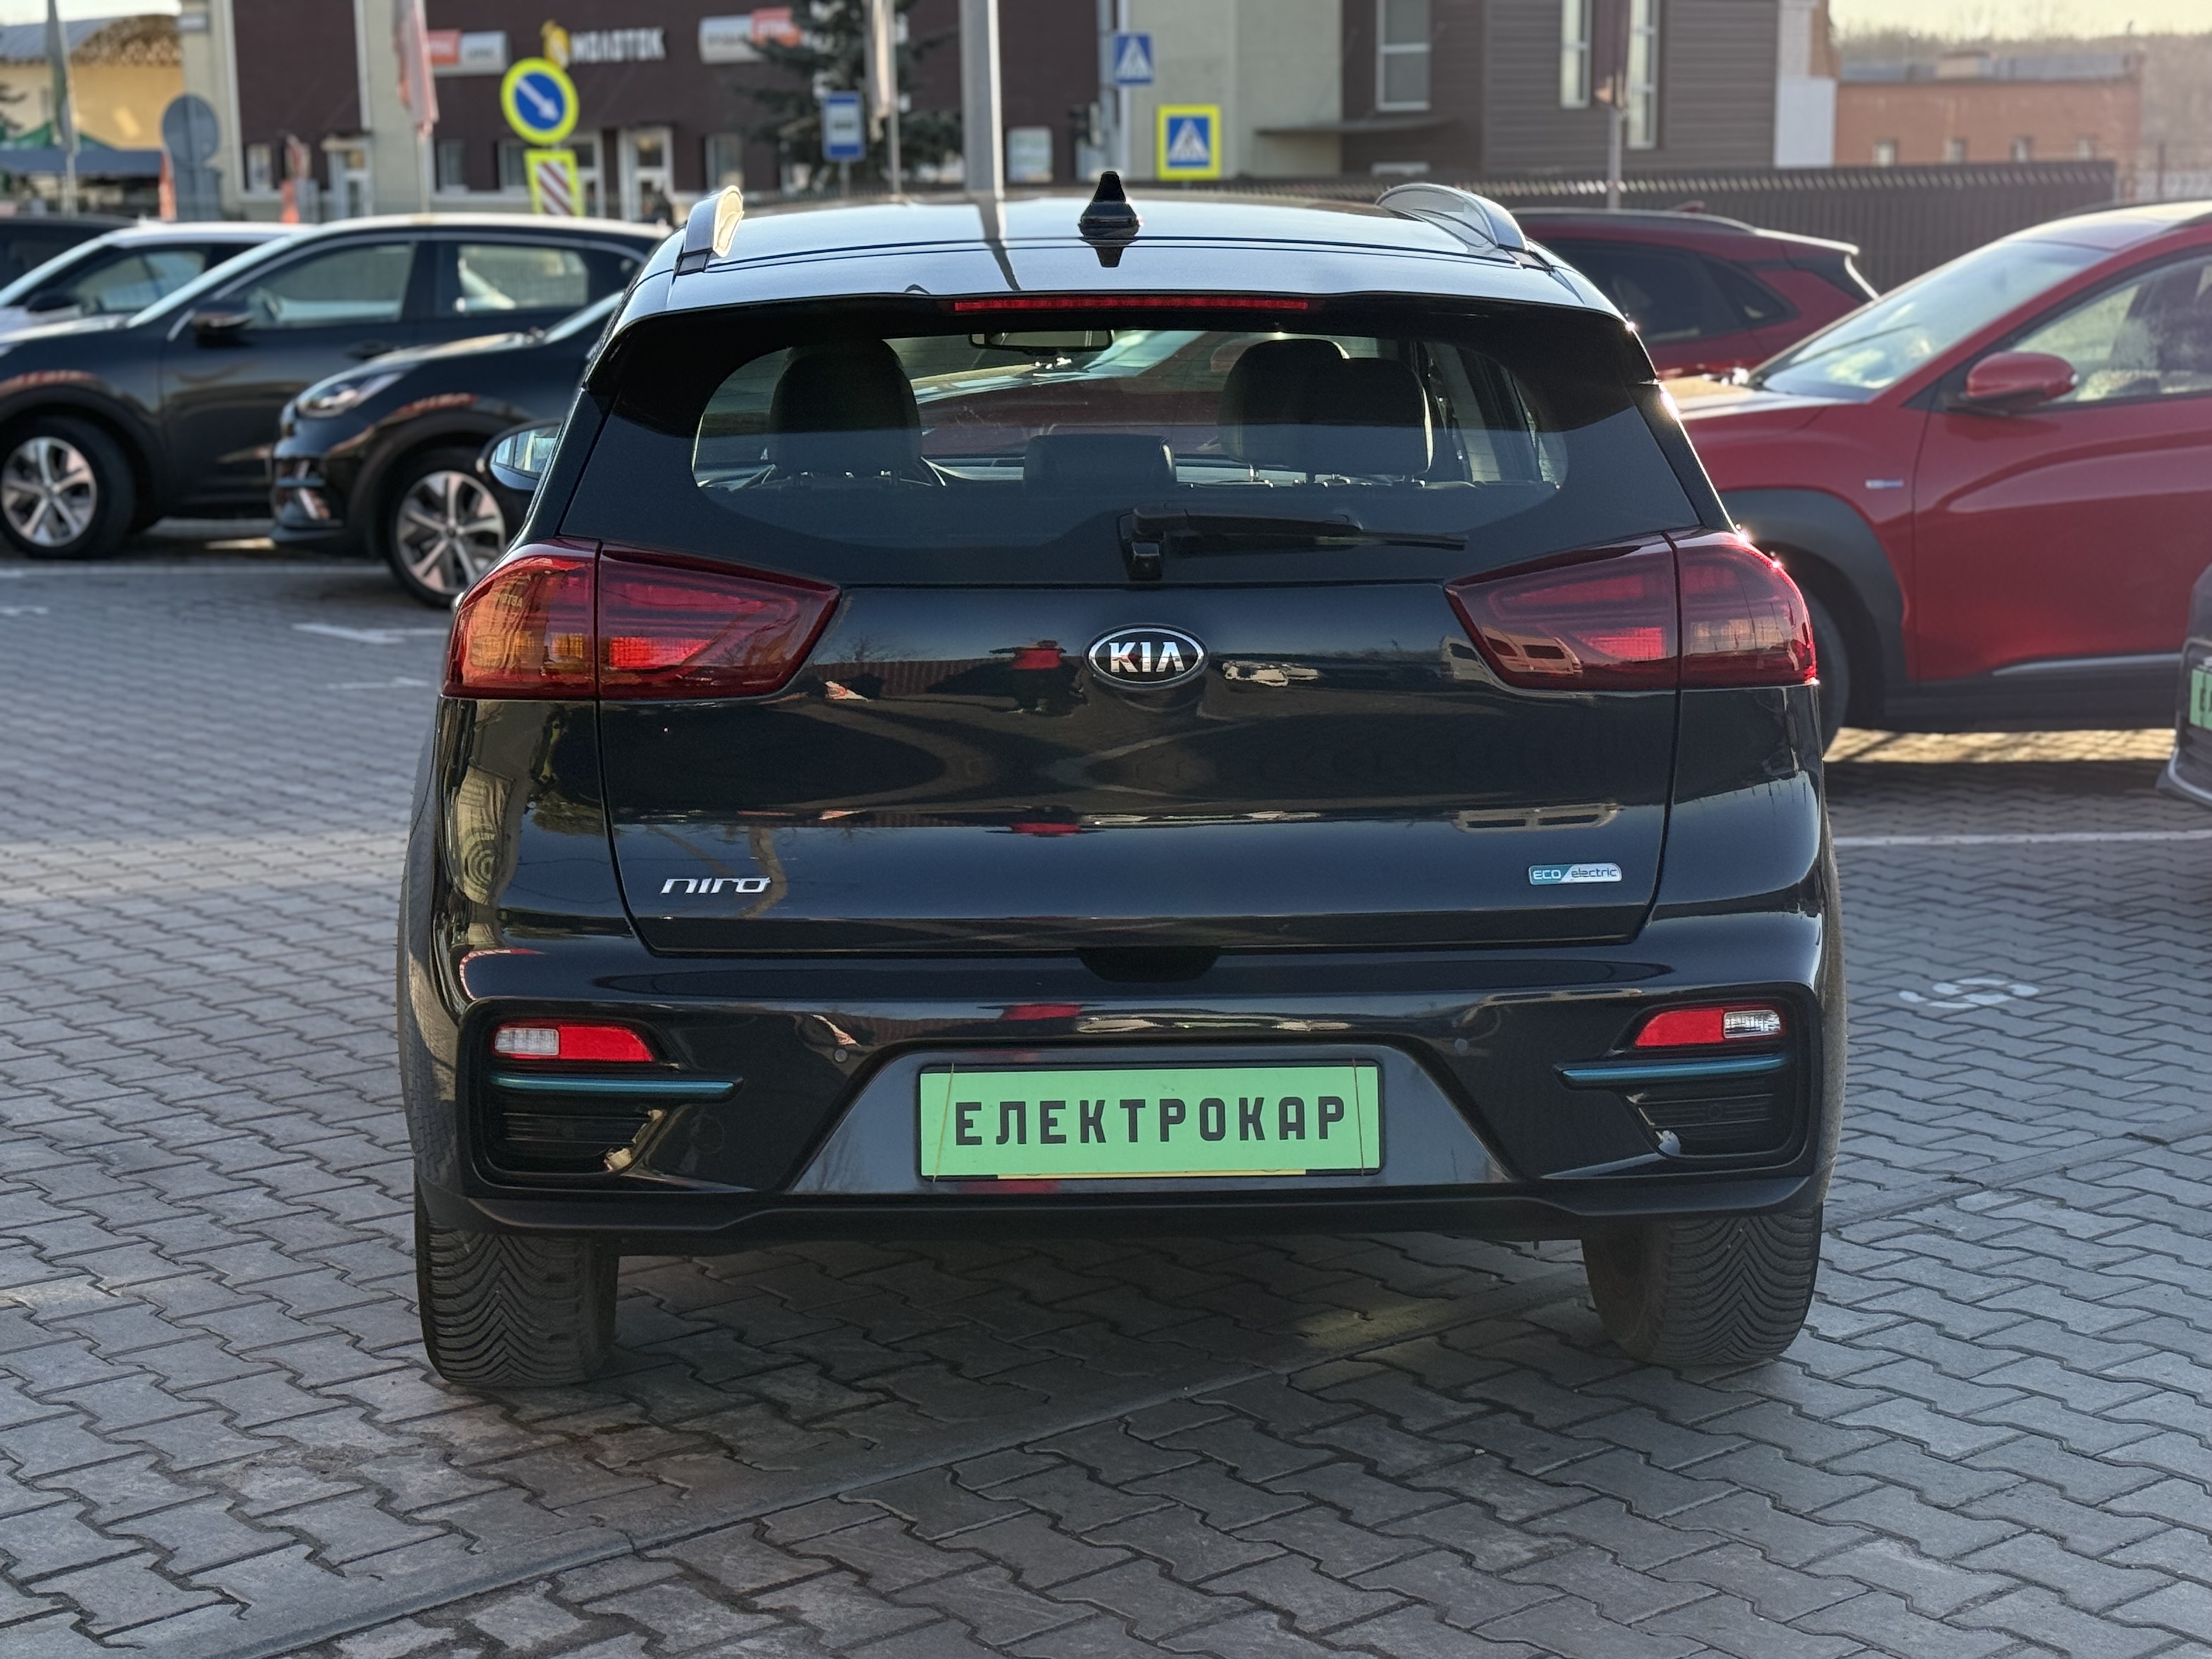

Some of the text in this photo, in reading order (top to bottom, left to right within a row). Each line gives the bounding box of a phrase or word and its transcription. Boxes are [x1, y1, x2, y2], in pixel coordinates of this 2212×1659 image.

[1109, 641, 1185, 673] KIA
[1571, 867, 1617, 878] electric
[660, 877, 771, 894] niro
[955, 1097, 1345, 1146] ЕЛЕКТРОКАР
